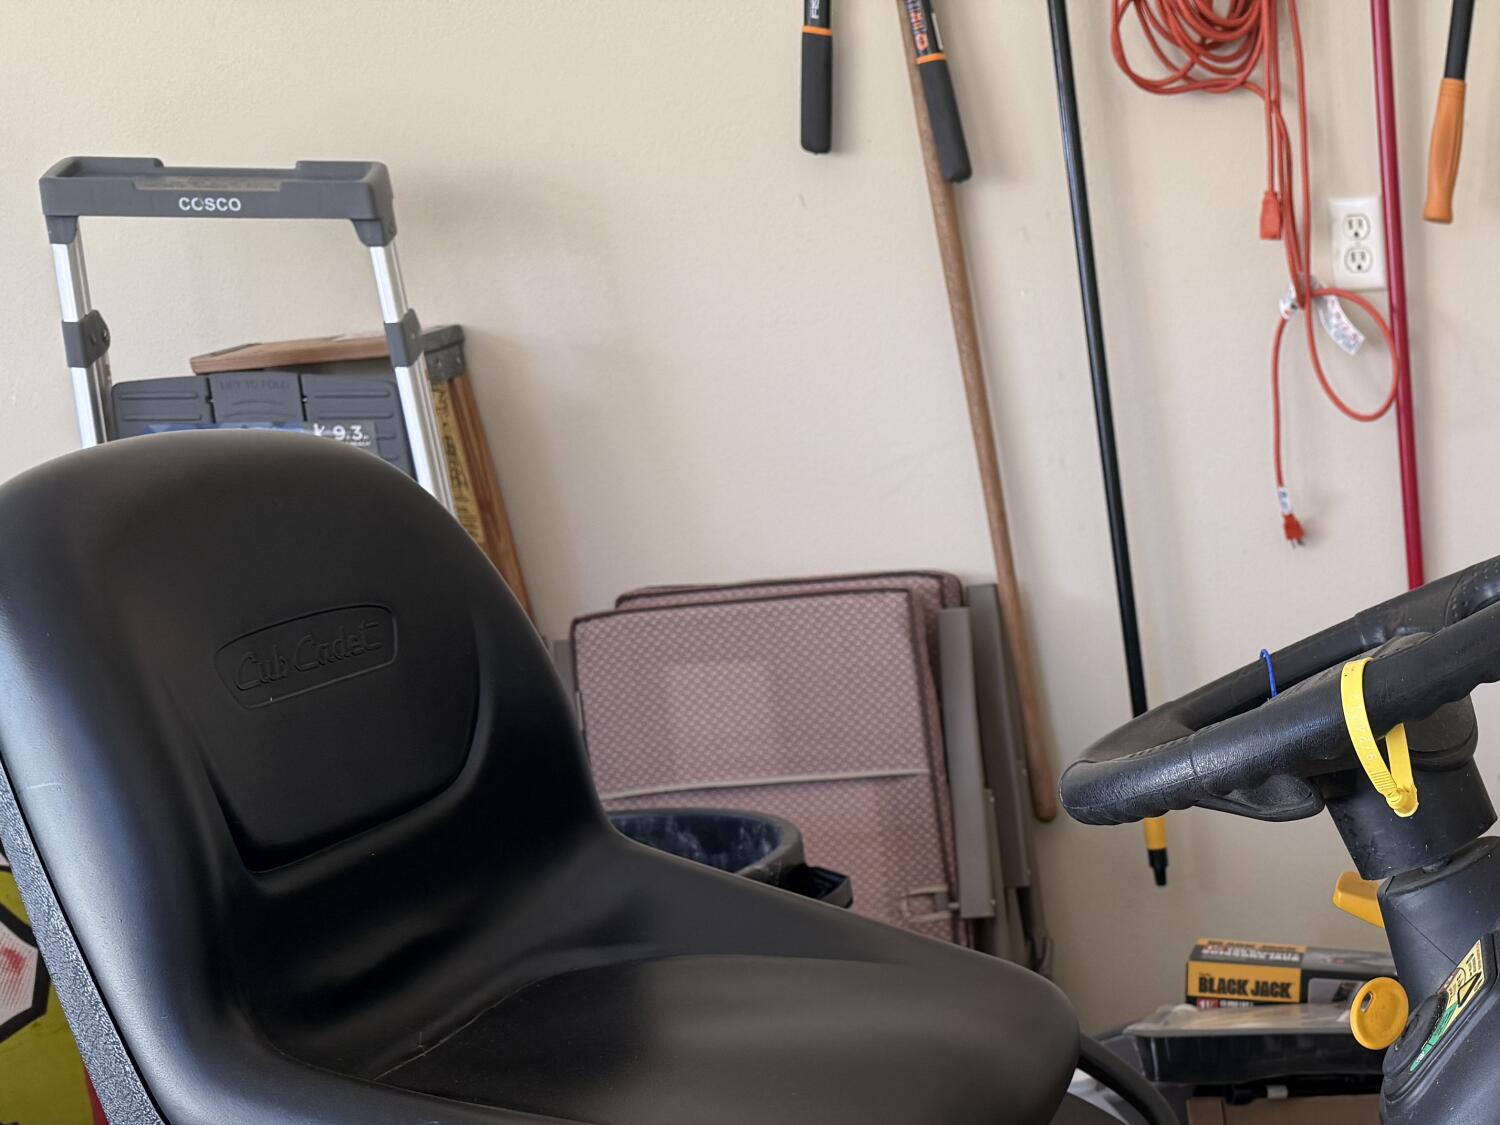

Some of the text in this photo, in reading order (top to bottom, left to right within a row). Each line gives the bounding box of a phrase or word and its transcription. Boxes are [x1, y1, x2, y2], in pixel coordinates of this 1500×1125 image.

[178, 196, 242, 212] COSCO
[234, 619, 382, 691] Cub Cadet
[1198, 976, 1293, 999] BLACK JACK
